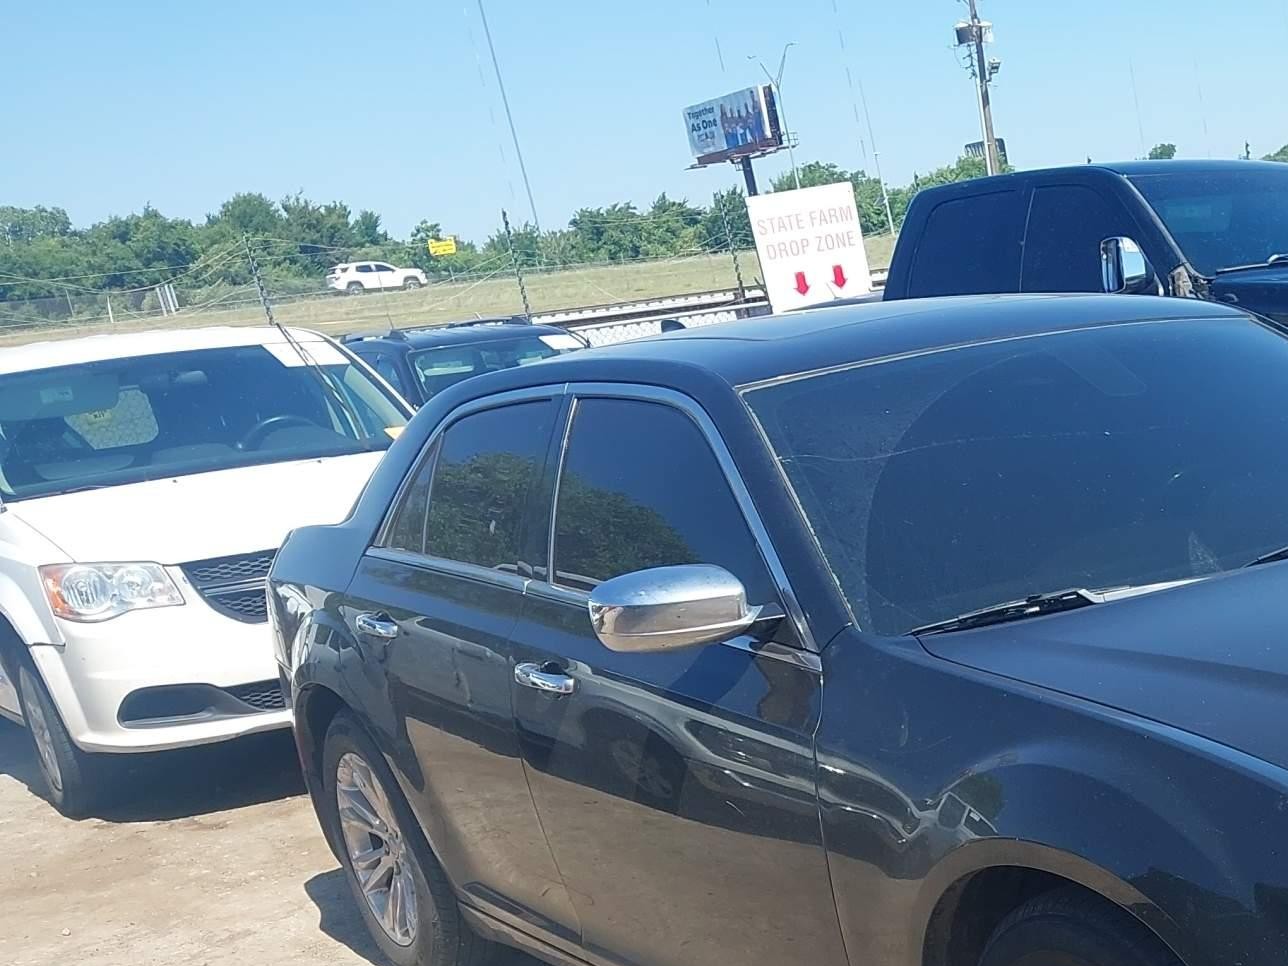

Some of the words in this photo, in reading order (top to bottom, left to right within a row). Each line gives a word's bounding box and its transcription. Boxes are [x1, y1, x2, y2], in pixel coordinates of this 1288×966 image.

[687, 106, 714, 120] Together
[691, 122, 701, 133] As
[701, 118, 717, 129] One
[757, 213, 805, 236] STATE
[809, 206, 853, 227] FARM
[766, 238, 809, 260] DROP
[815, 231, 856, 253] ZONE
